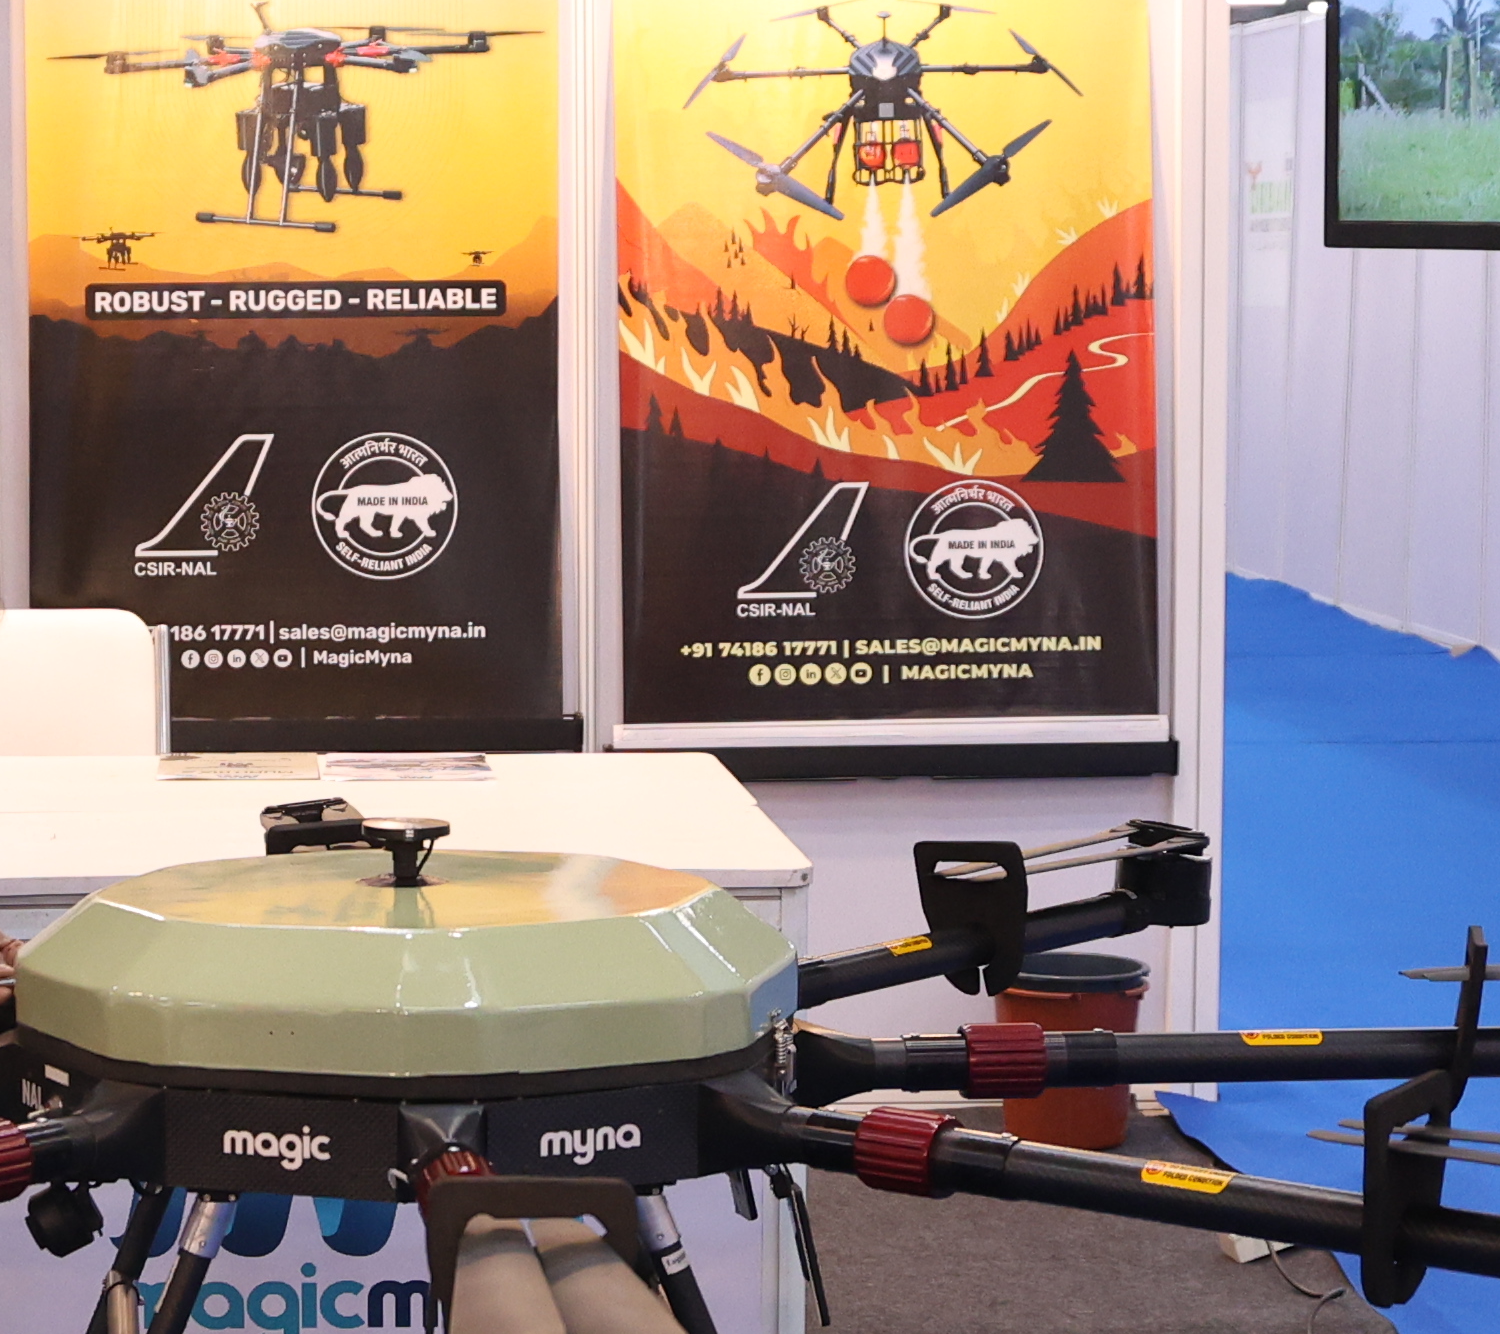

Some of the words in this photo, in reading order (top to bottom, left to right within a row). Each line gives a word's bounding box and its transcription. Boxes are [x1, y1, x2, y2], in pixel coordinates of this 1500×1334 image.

[93, 289, 206, 314] ROBUST
[228, 288, 342, 313] RUGGED
[366, 287, 498, 312] RELIABLE
[398, 443, 429, 468] भारत
[357, 496, 386, 507] MADE
[388, 496, 399, 506] IN
[401, 496, 429, 506] INDIA
[986, 489, 1016, 513] भारत
[335, 540, 405, 571] SELF-RELIANT
[404, 542, 433, 567] INDIA
[948, 540, 975, 550] MADE
[977, 540, 988, 549] IN
[990, 539, 1016, 549] INDIA
[134, 560, 218, 577] CSIR-NAL
[926, 582, 994, 611] SELF-RELIANT
[993, 583, 1021, 607] INDIA
[736, 603, 817, 618] CSIR-NAL
[210, 624, 266, 641] 17771
[278, 622, 487, 643] sales@magicmyna.in
[679, 642, 714, 658] +91
[718, 641, 778, 658] 74186
[783, 639, 838, 657] 17771
[854, 635, 1102, 656] SALES@MAGICMYNA.IN
[312, 649, 413, 667] MagicMyna
[900, 663, 1034, 681] MAGICMYNA
[222, 1125, 331, 1171] magic
[539, 1122, 642, 1165] myna
